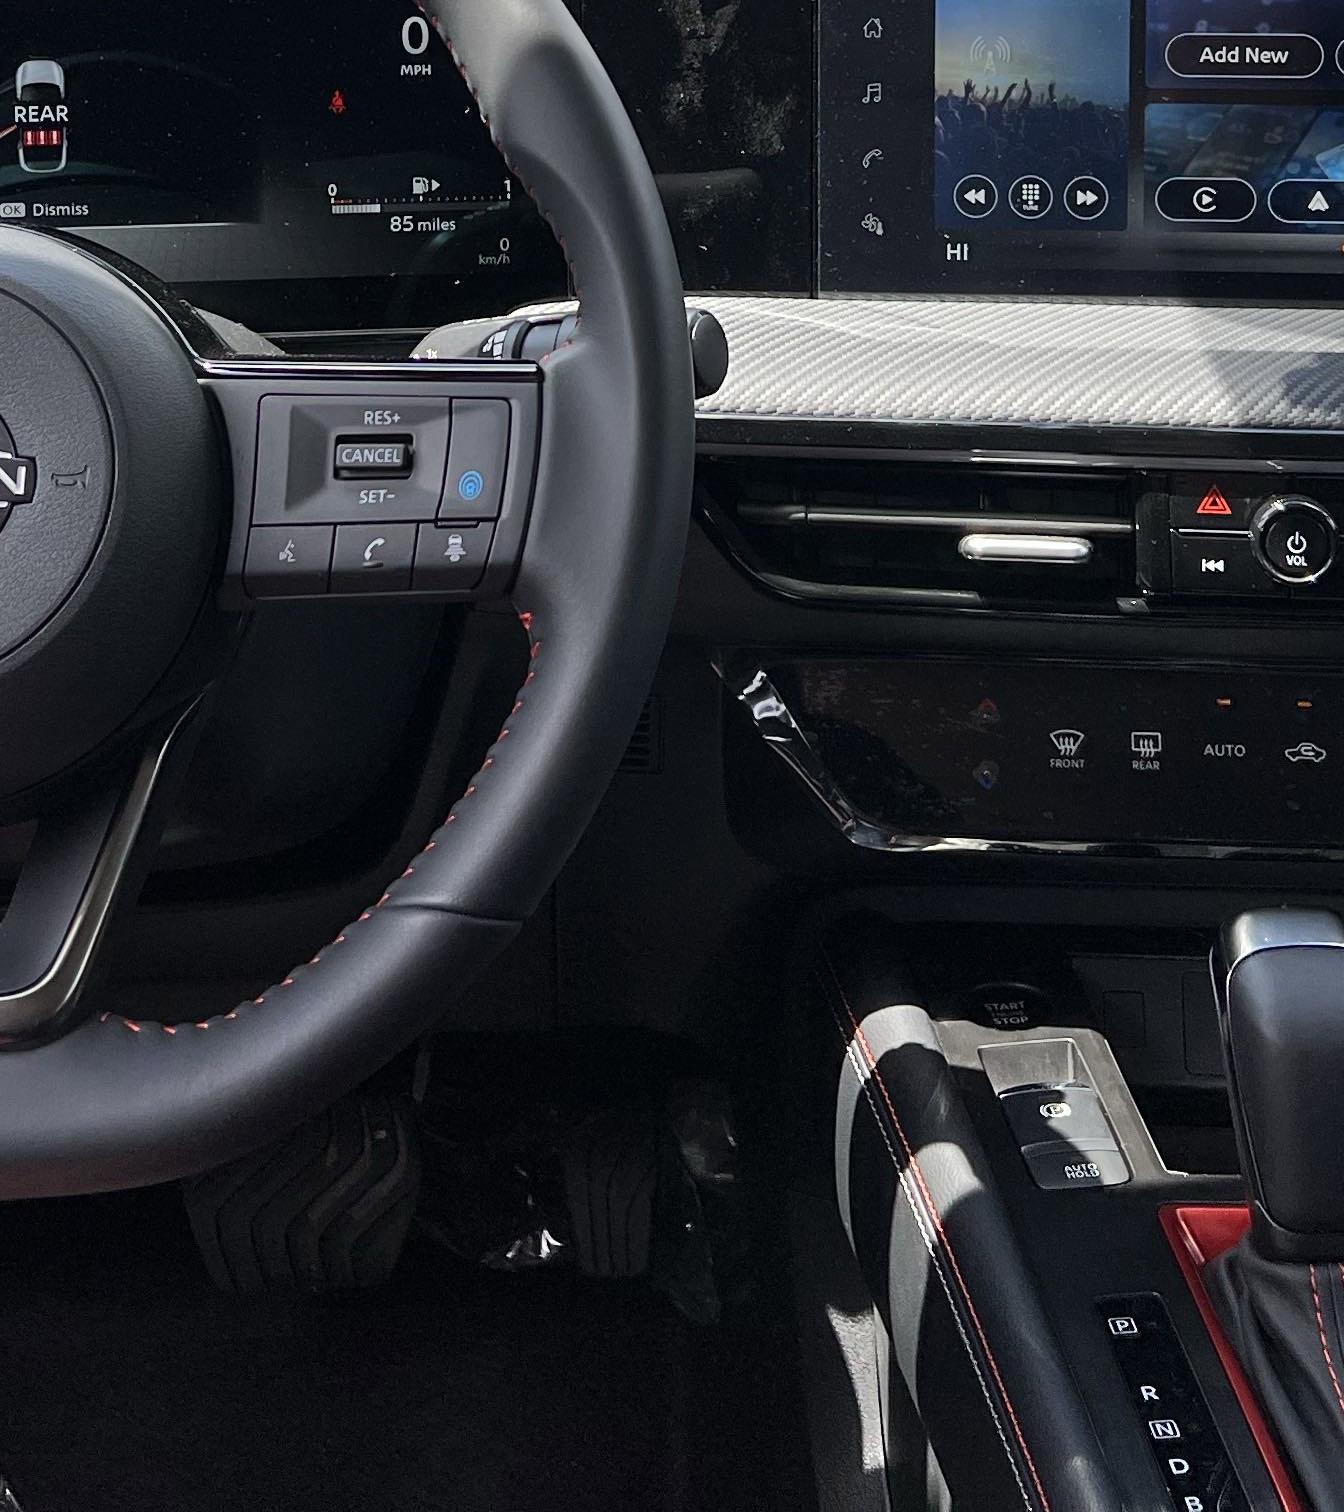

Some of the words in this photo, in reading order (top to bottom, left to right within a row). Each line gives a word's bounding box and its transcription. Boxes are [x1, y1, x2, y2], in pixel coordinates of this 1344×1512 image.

[401, 15, 430, 56] 0
[1199, 46, 1244, 64] Add
[1248, 47, 1289, 65] New
[400, 63, 432, 76] MPH
[13, 105, 69, 123] REAR
[327, 183, 338, 197] 0
[2, 204, 23, 216] OK
[33, 202, 89, 217] Dismiss
[389, 215, 415, 233] 85
[416, 216, 456, 233] miles
[499, 237, 510, 253] 0
[946, 243, 969, 261] HI
[478, 253, 511, 266] km/h
[364, 411, 401, 425] RES+
[341, 448, 401, 464] CANCEL
[1286, 555, 1307, 567] VOL
[1203, 743, 1246, 758] AUTO
[1049, 758, 1085, 769] FRONT
[1132, 760, 1160, 770] REAR
[984, 1000, 1025, 1011] START
[993, 1015, 1029, 1025] STOP
[1064, 1163, 1098, 1173] AUTO
[1066, 1169, 1100, 1179] HOLD
[1116, 1320, 1129, 1332] P
[1140, 1385, 1160, 1401] R
[1155, 1423, 1174, 1437] N
[1168, 1458, 1190, 1475] D
[1184, 1495, 1204, 1512] B
